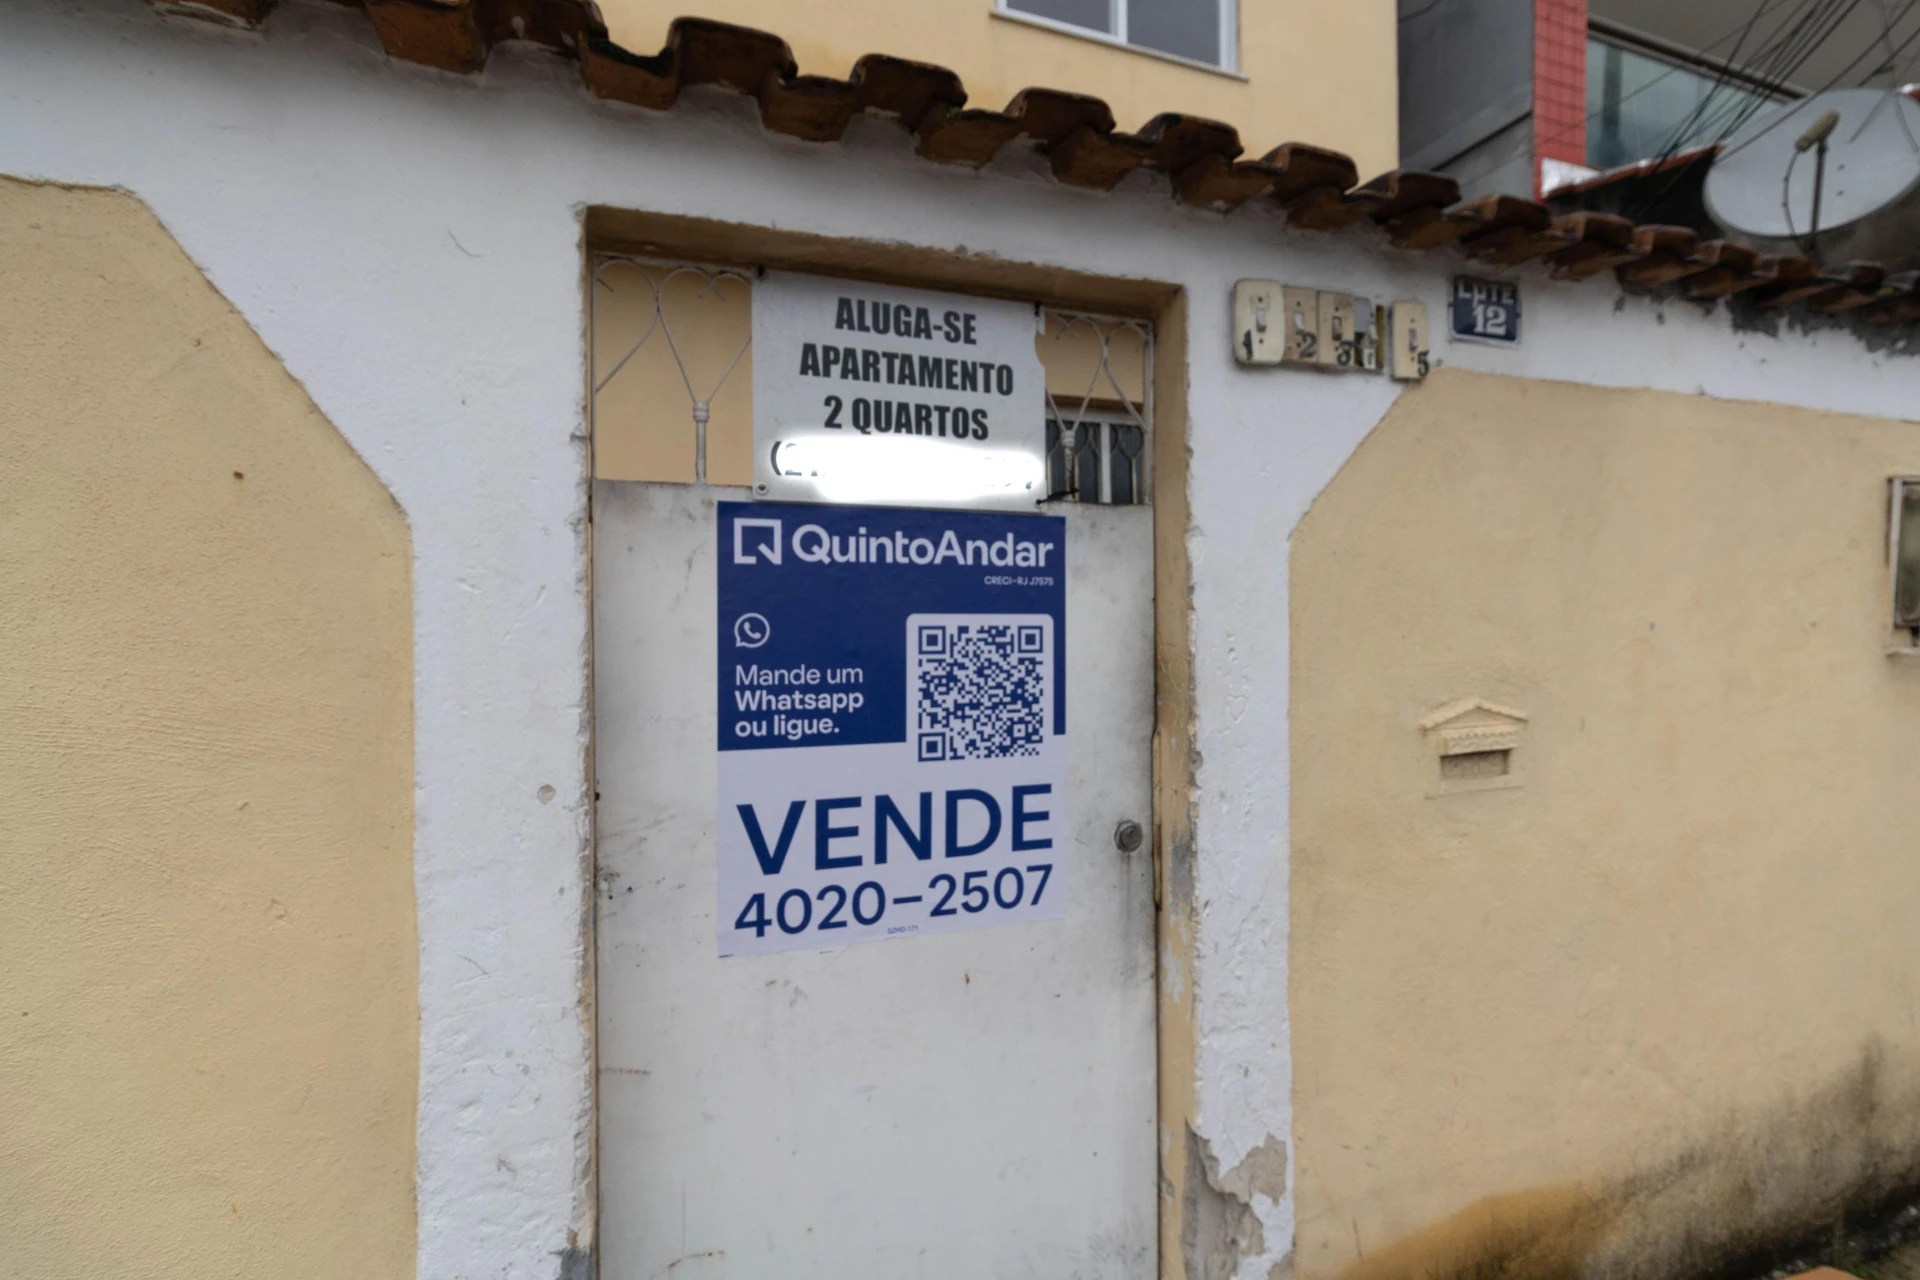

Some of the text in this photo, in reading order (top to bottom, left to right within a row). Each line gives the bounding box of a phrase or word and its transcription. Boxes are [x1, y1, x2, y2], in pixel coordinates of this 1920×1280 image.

[834, 297, 977, 345] ALUGA-SE
[1473, 305, 1507, 336] 12
[1300, 331, 1317, 358] 2
[1417, 350, 1430, 377] 5
[799, 342, 1014, 396] APARTAMENTO
[823, 395, 989, 441] 2 QUARTOS
[791, 523, 1054, 568] QuintoAndar
[735, 664, 864, 686] Mande um
[734, 689, 864, 713] Whatsapp
[734, 714, 840, 741] ou ligue.
[736, 783, 1053, 876] VENDE
[734, 863, 1053, 938] 4020-2507
